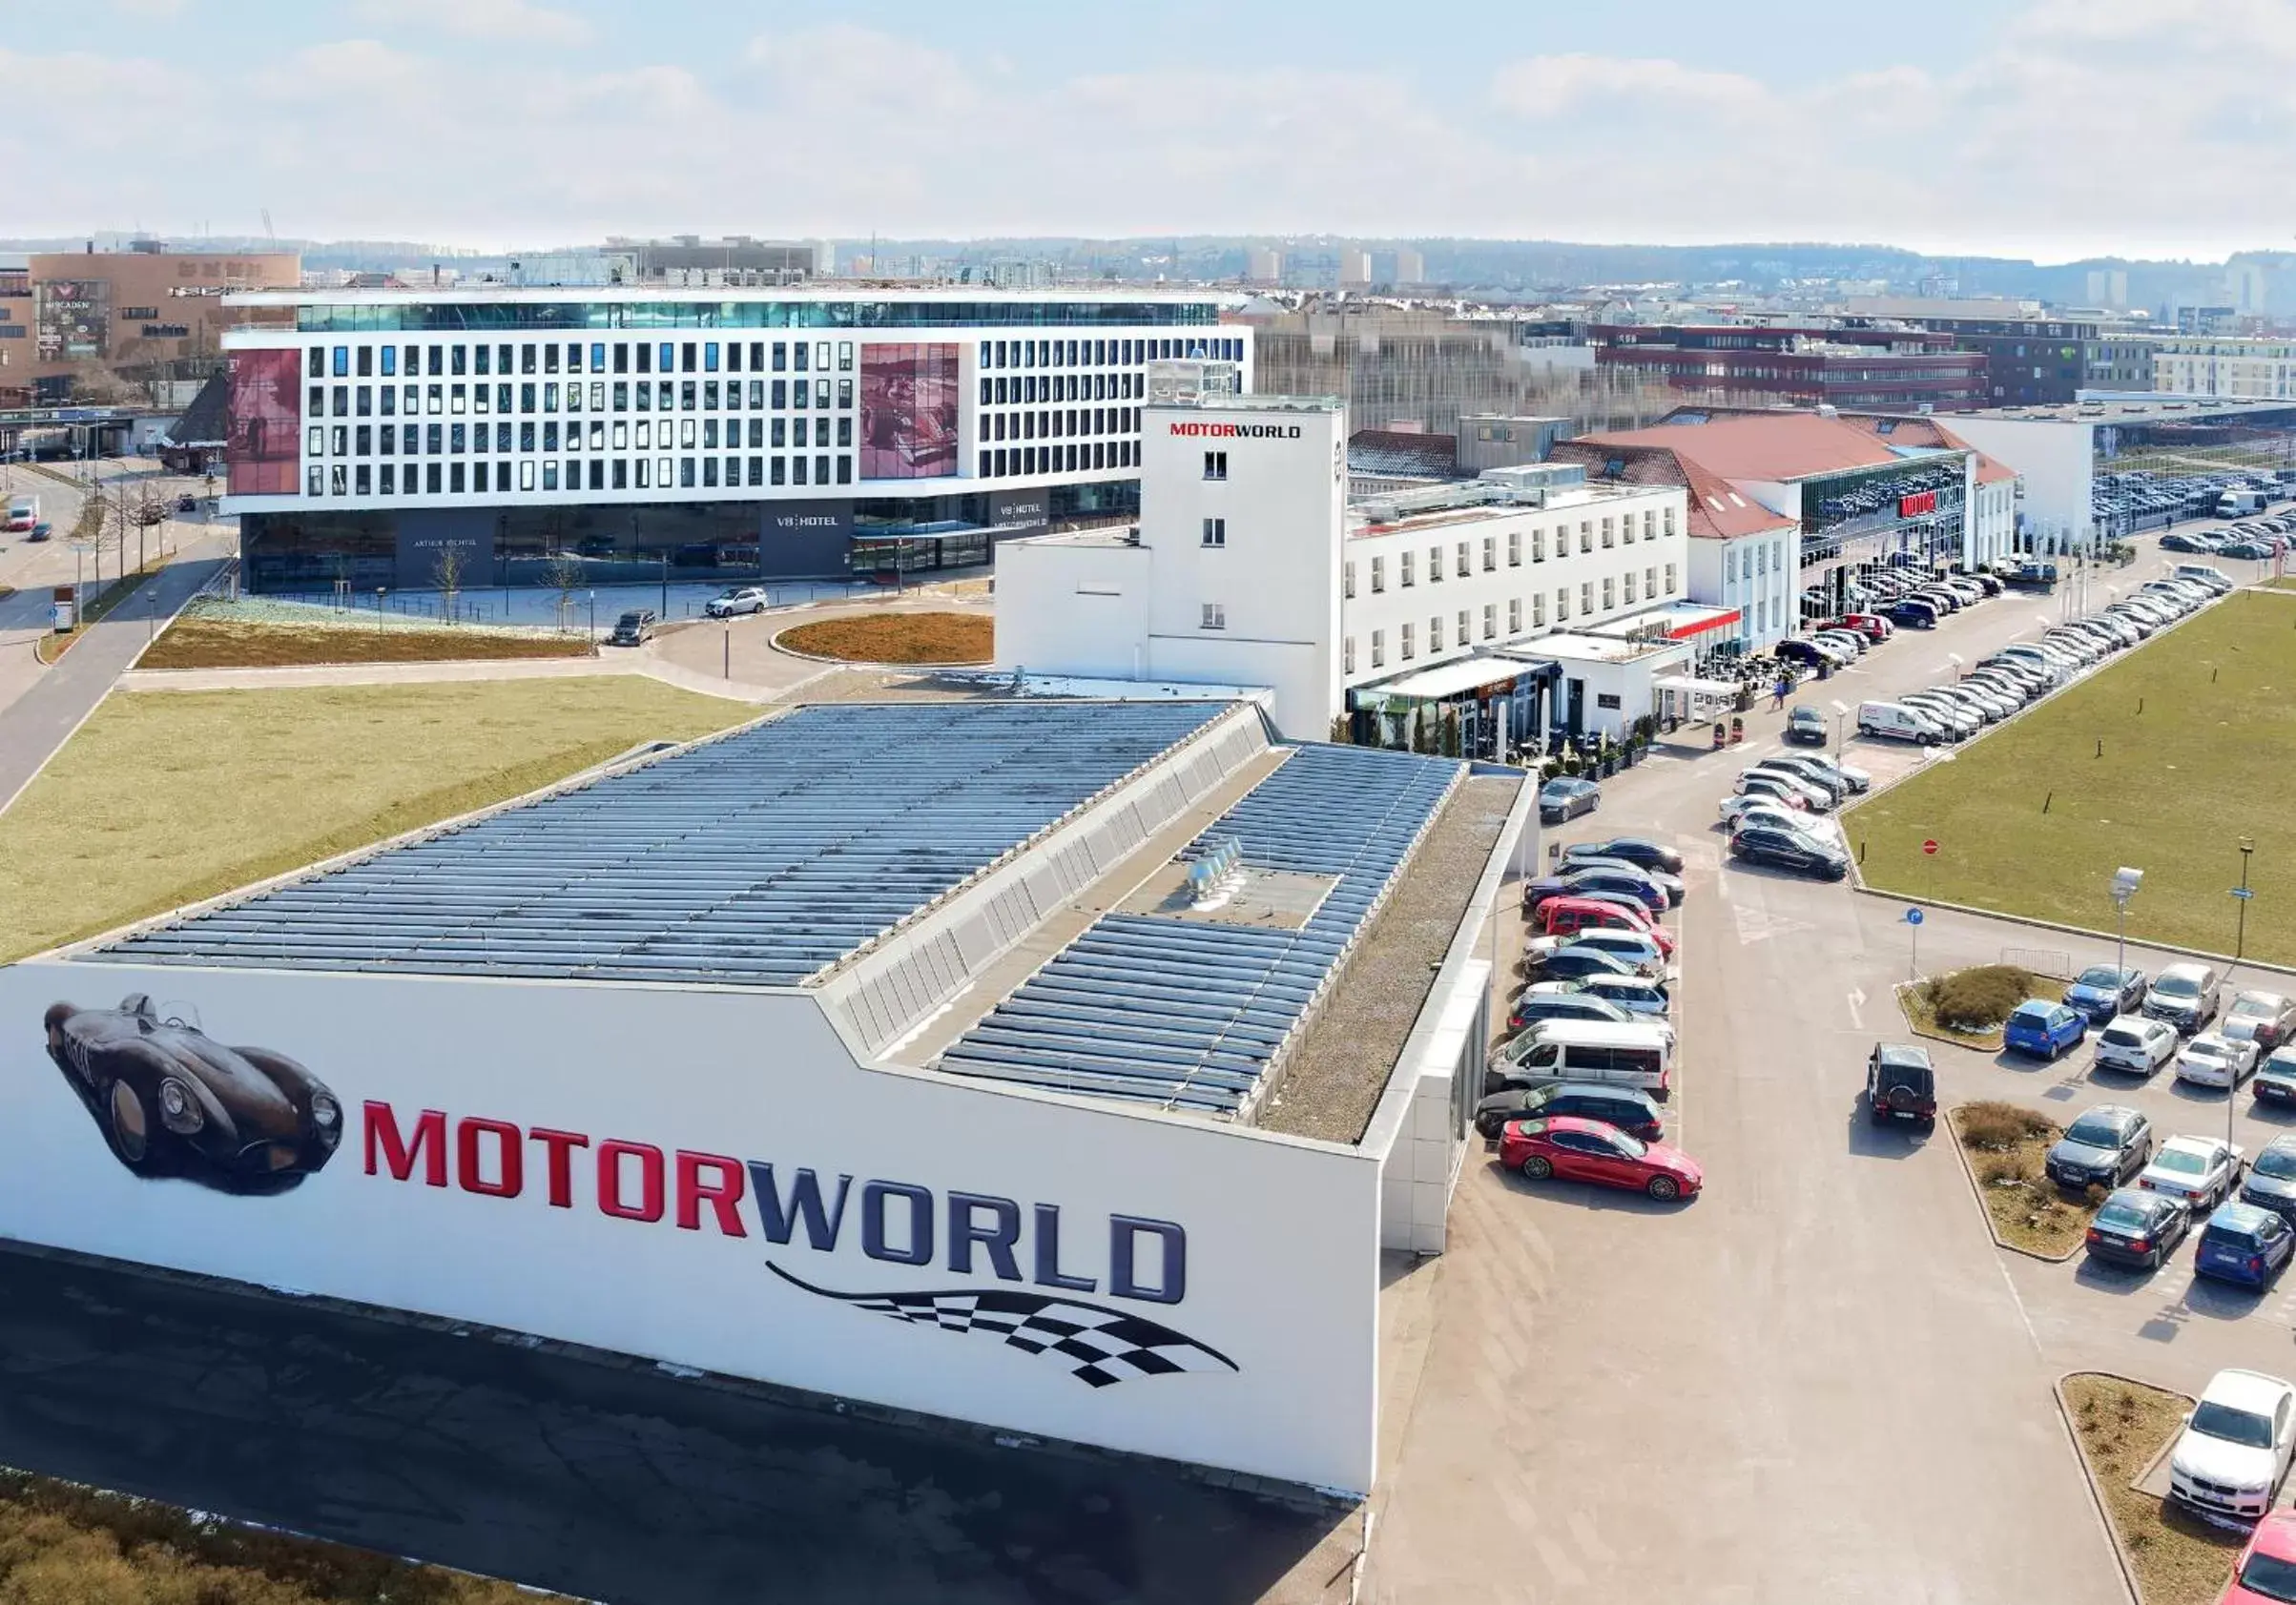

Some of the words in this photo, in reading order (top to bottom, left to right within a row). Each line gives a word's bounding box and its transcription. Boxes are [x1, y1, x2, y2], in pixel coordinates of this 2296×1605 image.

[1169, 422, 1301, 439] MOTORWORLD
[777, 517, 794, 526] V8
[799, 516, 838, 526] HOTEL
[363, 1099, 1186, 1305] MOTORWORLD
